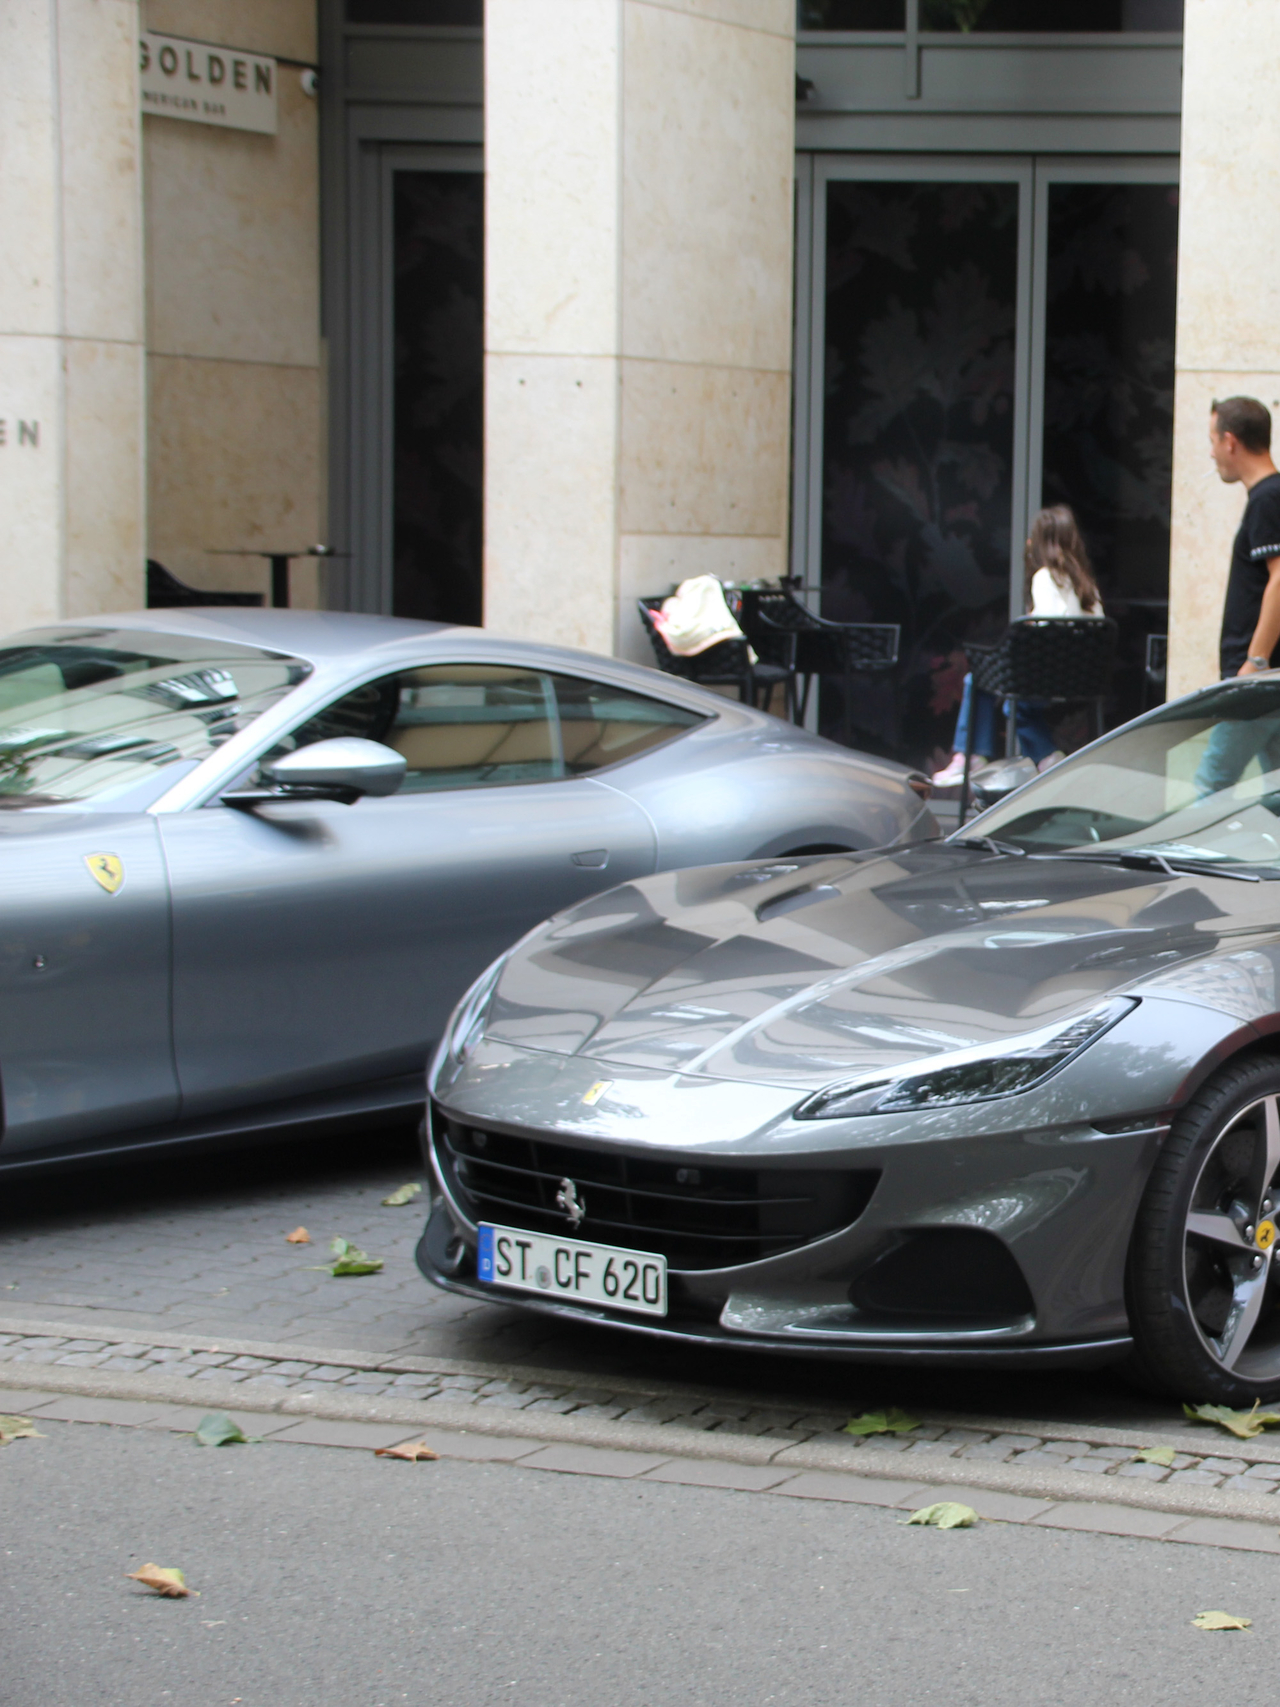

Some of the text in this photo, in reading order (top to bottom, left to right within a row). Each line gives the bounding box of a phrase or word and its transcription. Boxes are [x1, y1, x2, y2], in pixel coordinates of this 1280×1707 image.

[142, 91, 198, 110] MERICAN
[497, 1236, 533, 1281] ST
[555, 1247, 593, 1290] CF
[603, 1256, 660, 1305] 620
